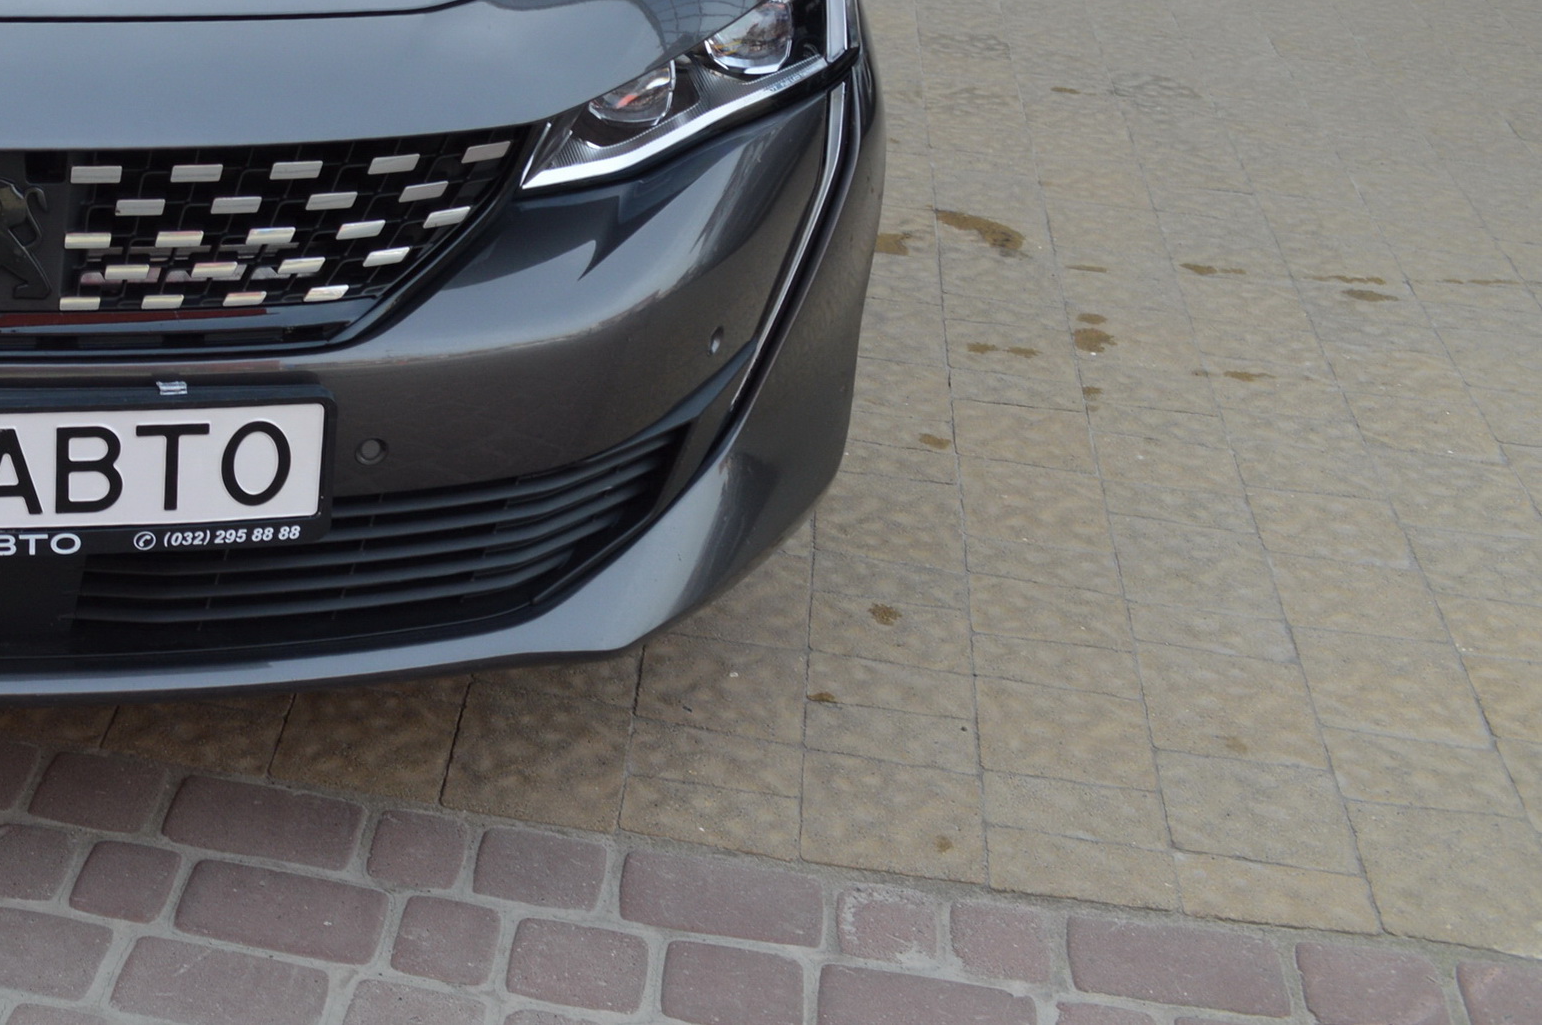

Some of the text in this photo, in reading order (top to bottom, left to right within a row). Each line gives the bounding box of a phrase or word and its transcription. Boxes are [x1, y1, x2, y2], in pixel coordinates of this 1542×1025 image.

[163, 525, 301, 548] (032) 295 88 88
